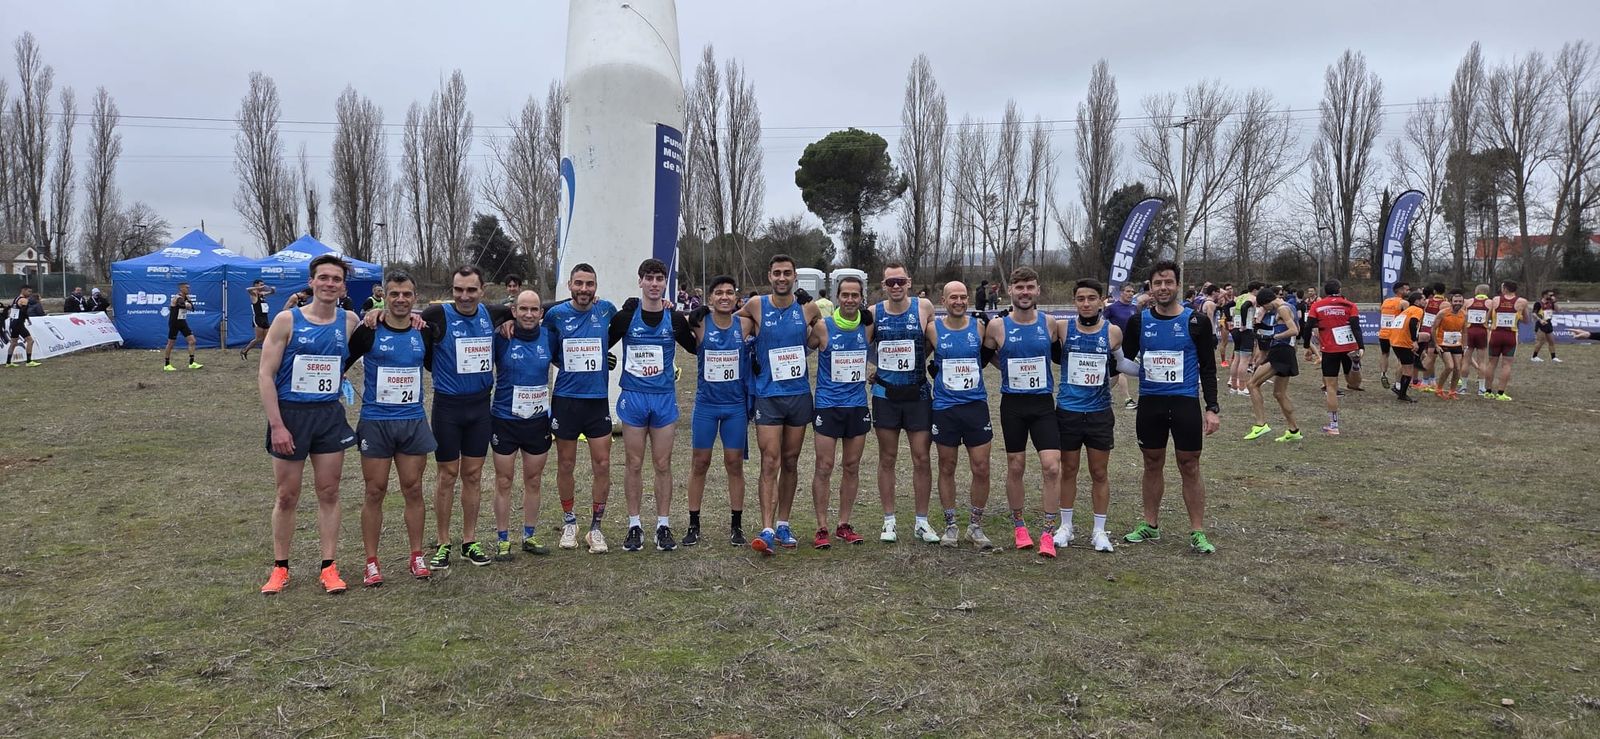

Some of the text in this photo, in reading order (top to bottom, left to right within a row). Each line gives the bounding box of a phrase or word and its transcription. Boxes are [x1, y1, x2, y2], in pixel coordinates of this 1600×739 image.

[663, 160, 675, 170] de
[1112, 240, 1136, 282] FMD
[1383, 240, 1403, 283] FMD
[777, 353, 799, 361] MANUEL
[1152, 356, 1176, 365] VICTOR
[306, 364, 332, 372] SERGIO
[480, 359, 490, 371] 23
[584, 359, 597, 371] 19
[898, 358, 910, 370] 84
[955, 365, 970, 373] IVAN
[642, 365, 659, 377] 300
[724, 368, 735, 380] 80
[790, 365, 801, 377] 82
[851, 370, 861, 382] 20
[1164, 370, 1176, 382] 18
[318, 378, 332, 392] 83
[964, 378, 974, 389] 21
[1029, 376, 1040, 388] 81
[1084, 373, 1100, 385] 301
[401, 390, 413, 403] 24
